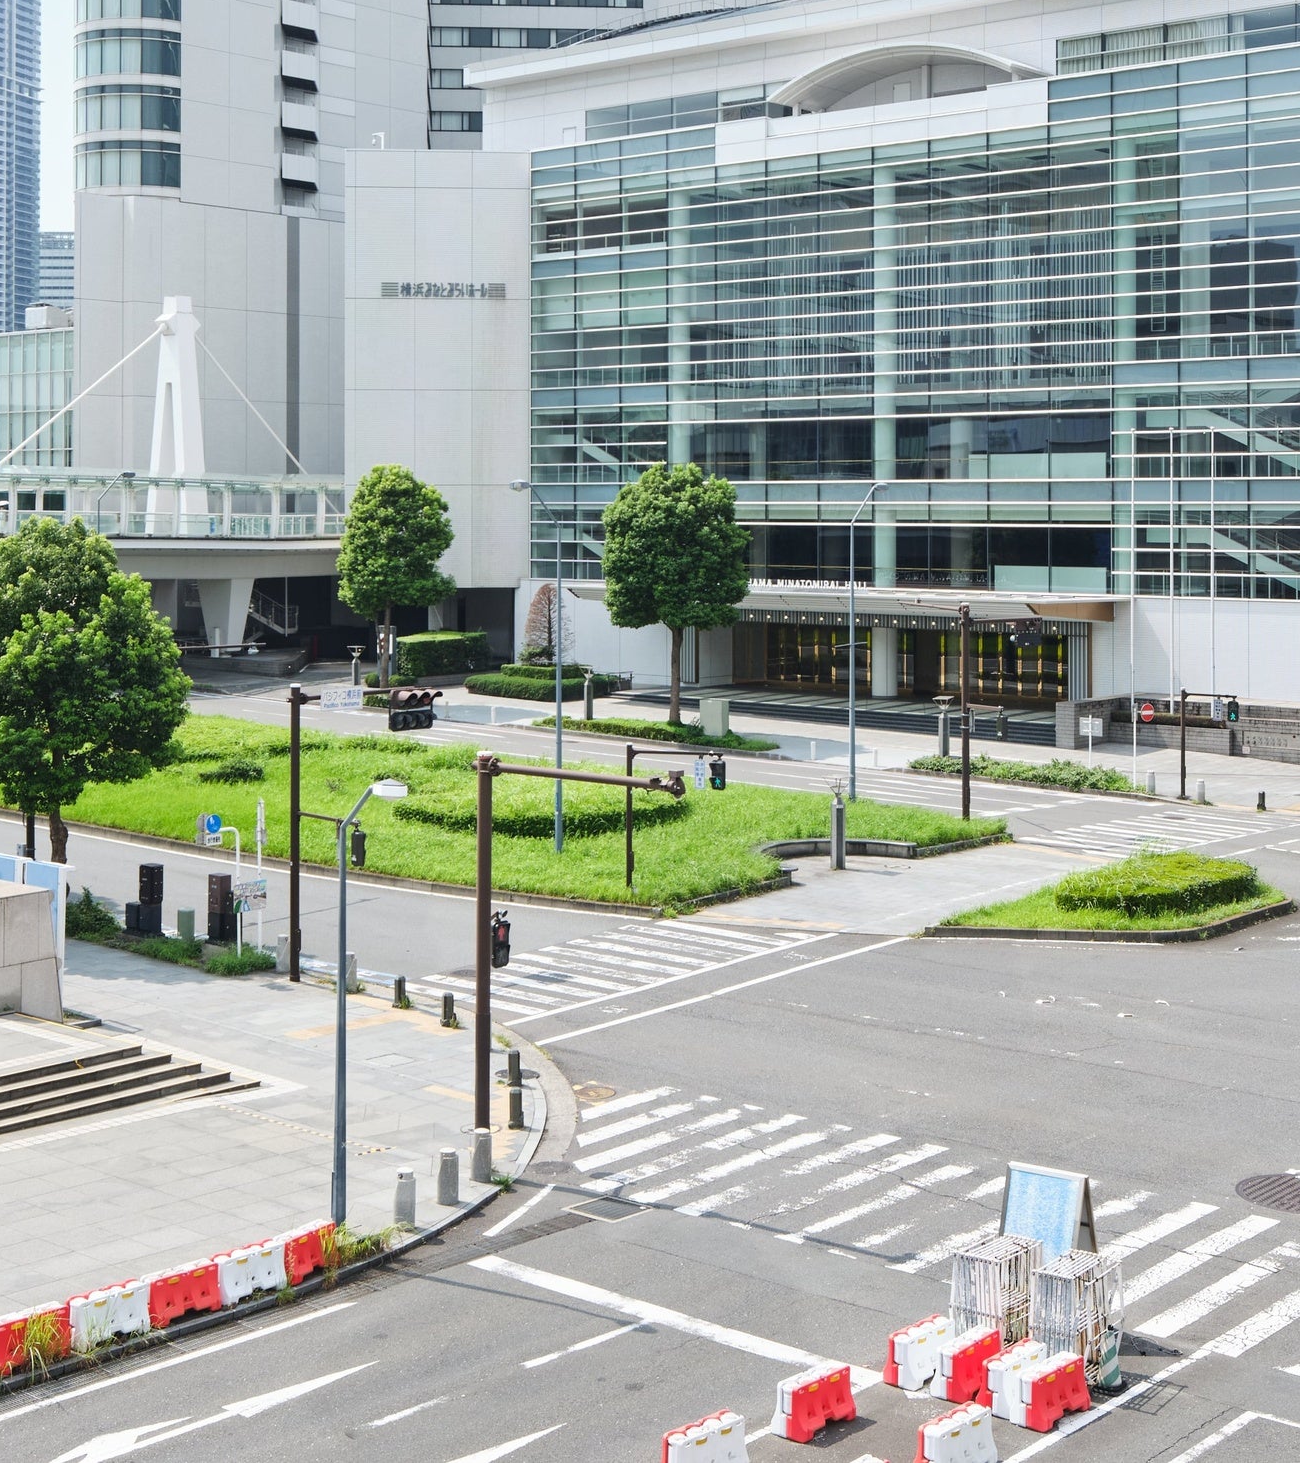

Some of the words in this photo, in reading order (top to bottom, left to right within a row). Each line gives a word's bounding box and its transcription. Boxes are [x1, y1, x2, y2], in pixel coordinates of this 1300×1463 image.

[400, 282, 488, 298] 横浜みなとみらいホール
[777, 579, 840, 589] MINATOMIRAI
[844, 580, 868, 590] HALL
